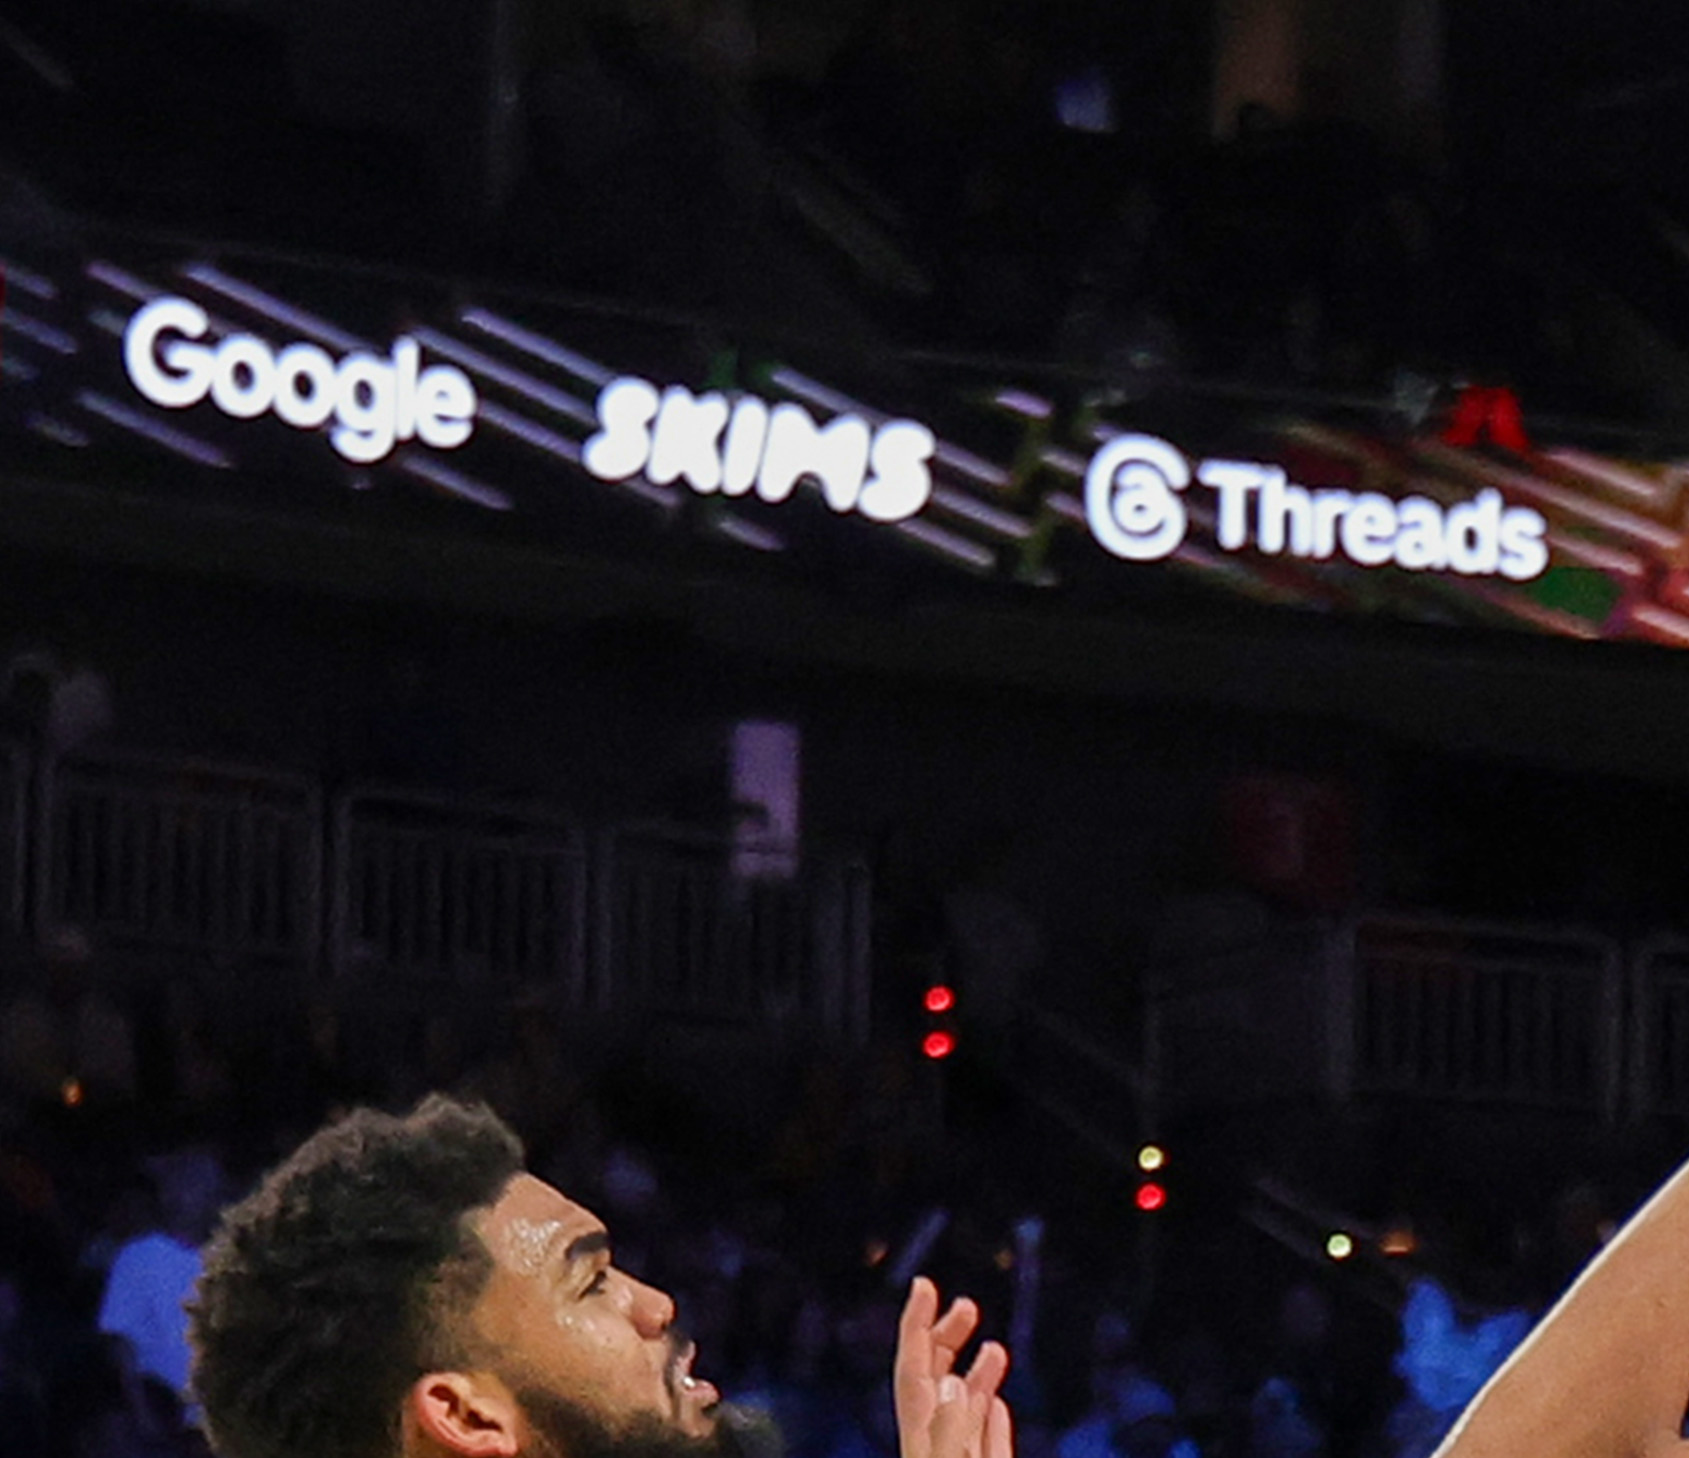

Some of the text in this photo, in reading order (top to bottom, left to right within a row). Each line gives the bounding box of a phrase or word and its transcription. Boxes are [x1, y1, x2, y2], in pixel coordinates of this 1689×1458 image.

[125, 297, 476, 463] Google
[584, 377, 935, 521] SKIMS
[1198, 458, 1548, 581] Threads
